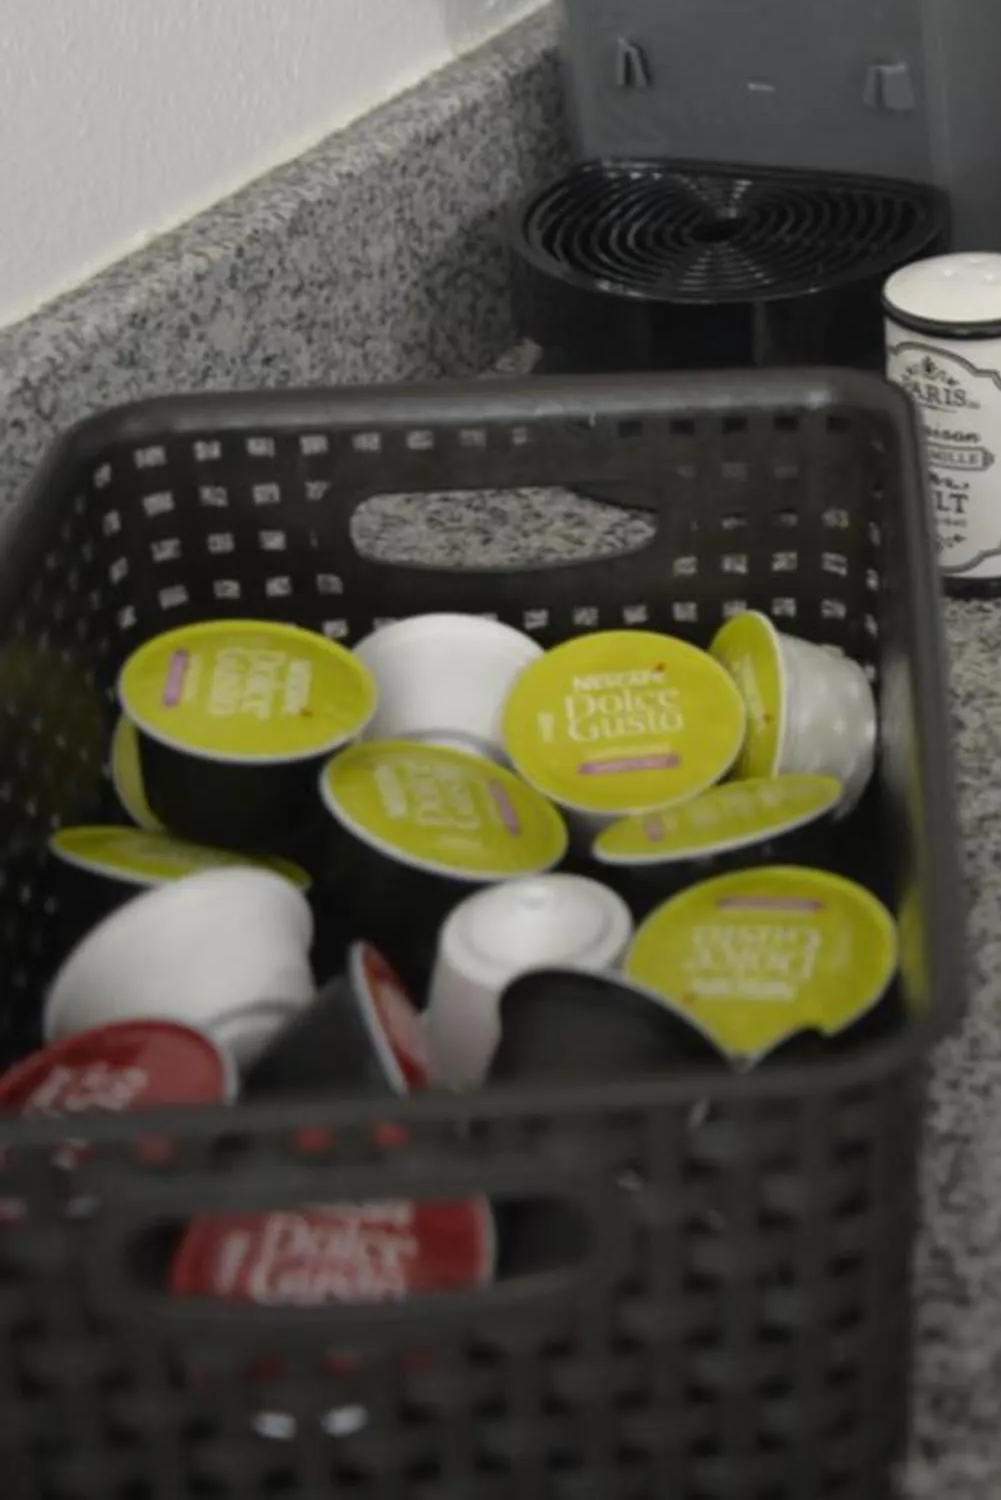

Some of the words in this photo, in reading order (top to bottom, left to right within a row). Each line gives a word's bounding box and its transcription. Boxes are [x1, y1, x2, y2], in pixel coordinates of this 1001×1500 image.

[923, 425, 982, 444] ison
[935, 489, 969, 514] LT
[564, 686, 681, 722] Dolce
[567, 709, 685, 742] Gusto
